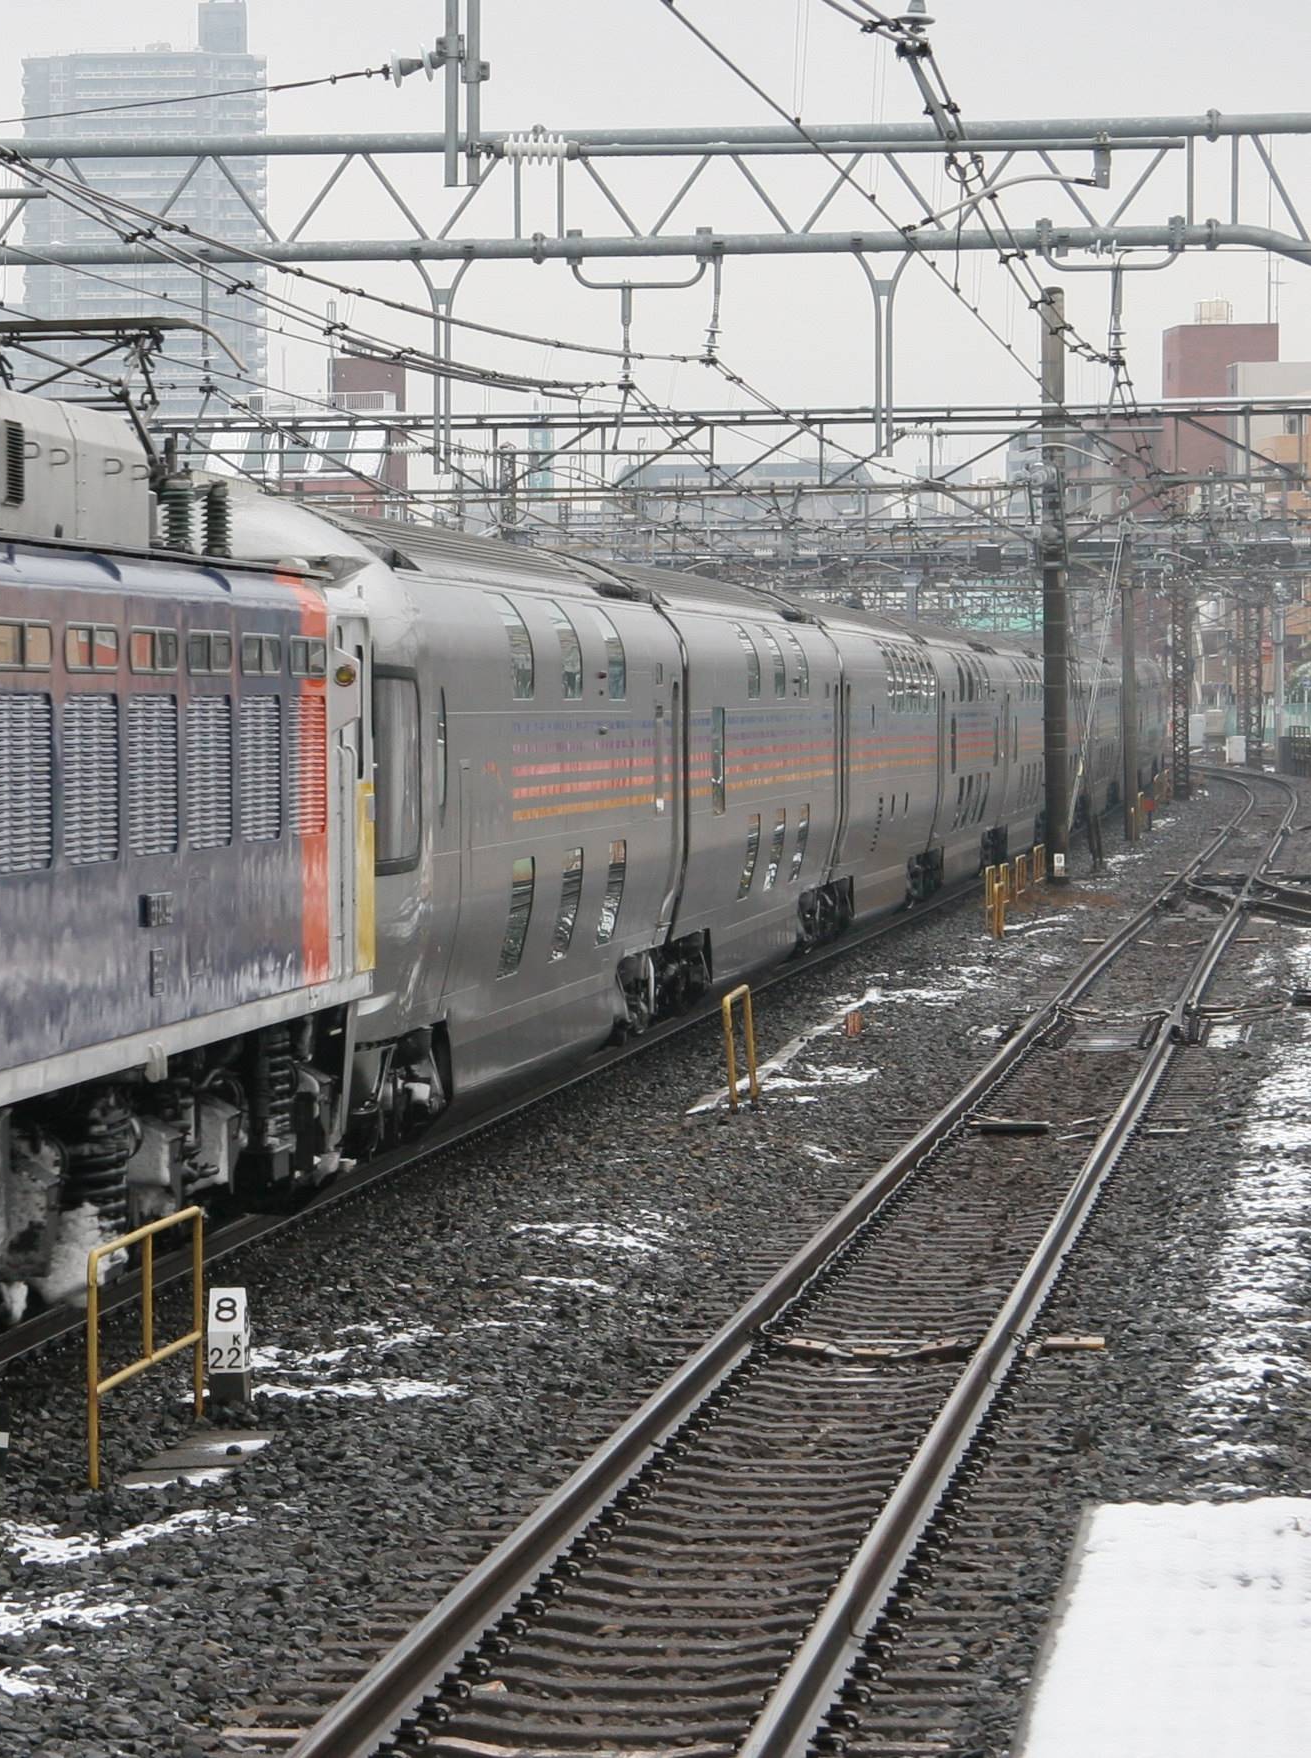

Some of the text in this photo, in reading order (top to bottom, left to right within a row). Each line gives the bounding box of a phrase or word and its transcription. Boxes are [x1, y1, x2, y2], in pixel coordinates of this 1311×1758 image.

[215, 1297, 237, 1322] 8
[232, 1334, 241, 1346] K
[209, 1347, 242, 1369] 22
